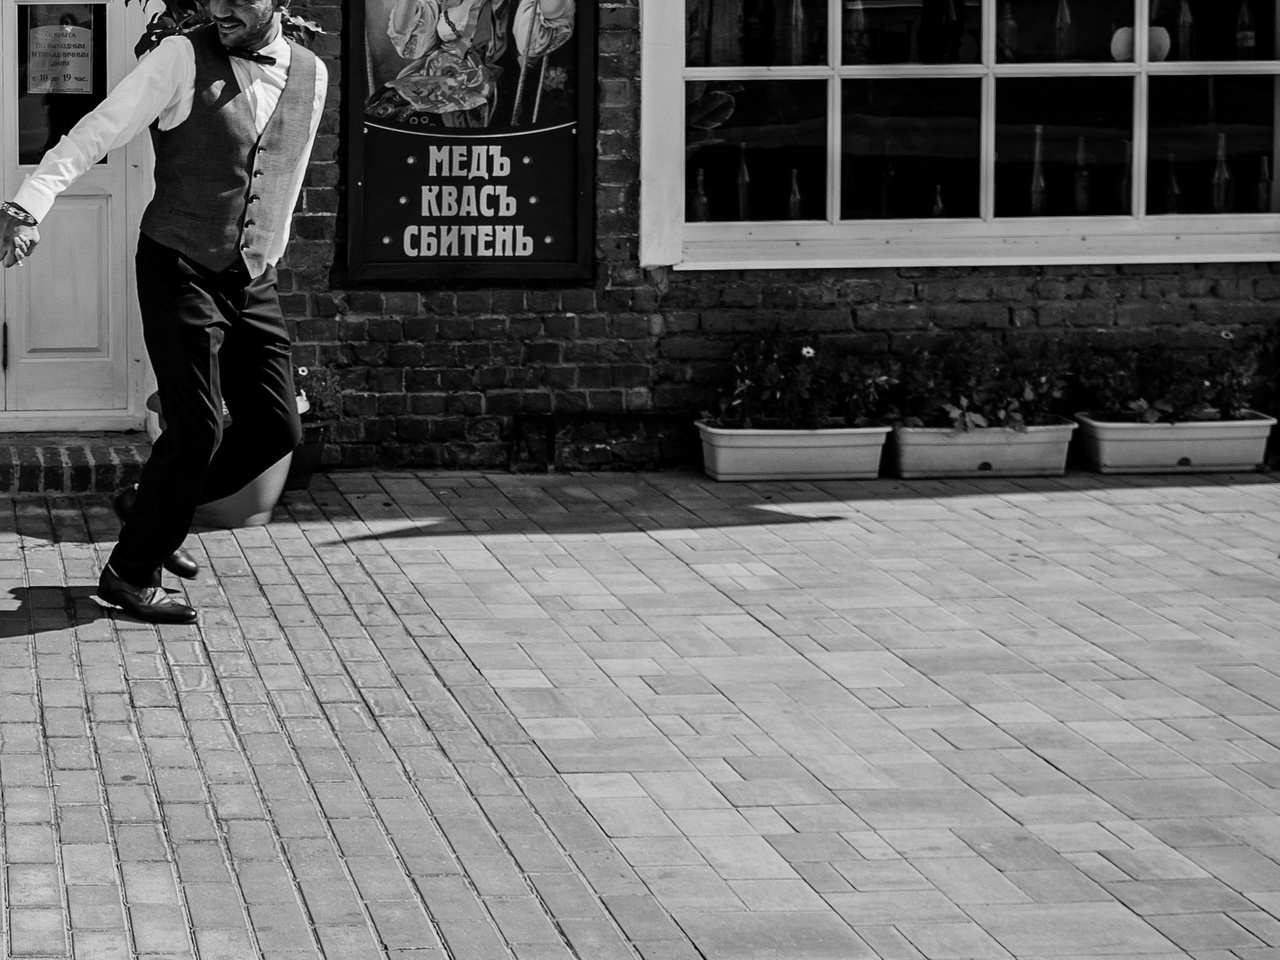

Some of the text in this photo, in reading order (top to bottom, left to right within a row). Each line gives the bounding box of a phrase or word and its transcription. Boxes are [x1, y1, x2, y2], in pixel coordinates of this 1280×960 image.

[40, 73, 49, 82] 10
[63, 73, 72, 82] 19
[428, 145, 511, 180] МЕДЪ
[421, 185, 517, 217] КВАСЪ
[403, 224, 534, 257] СБИТЕНЬ
